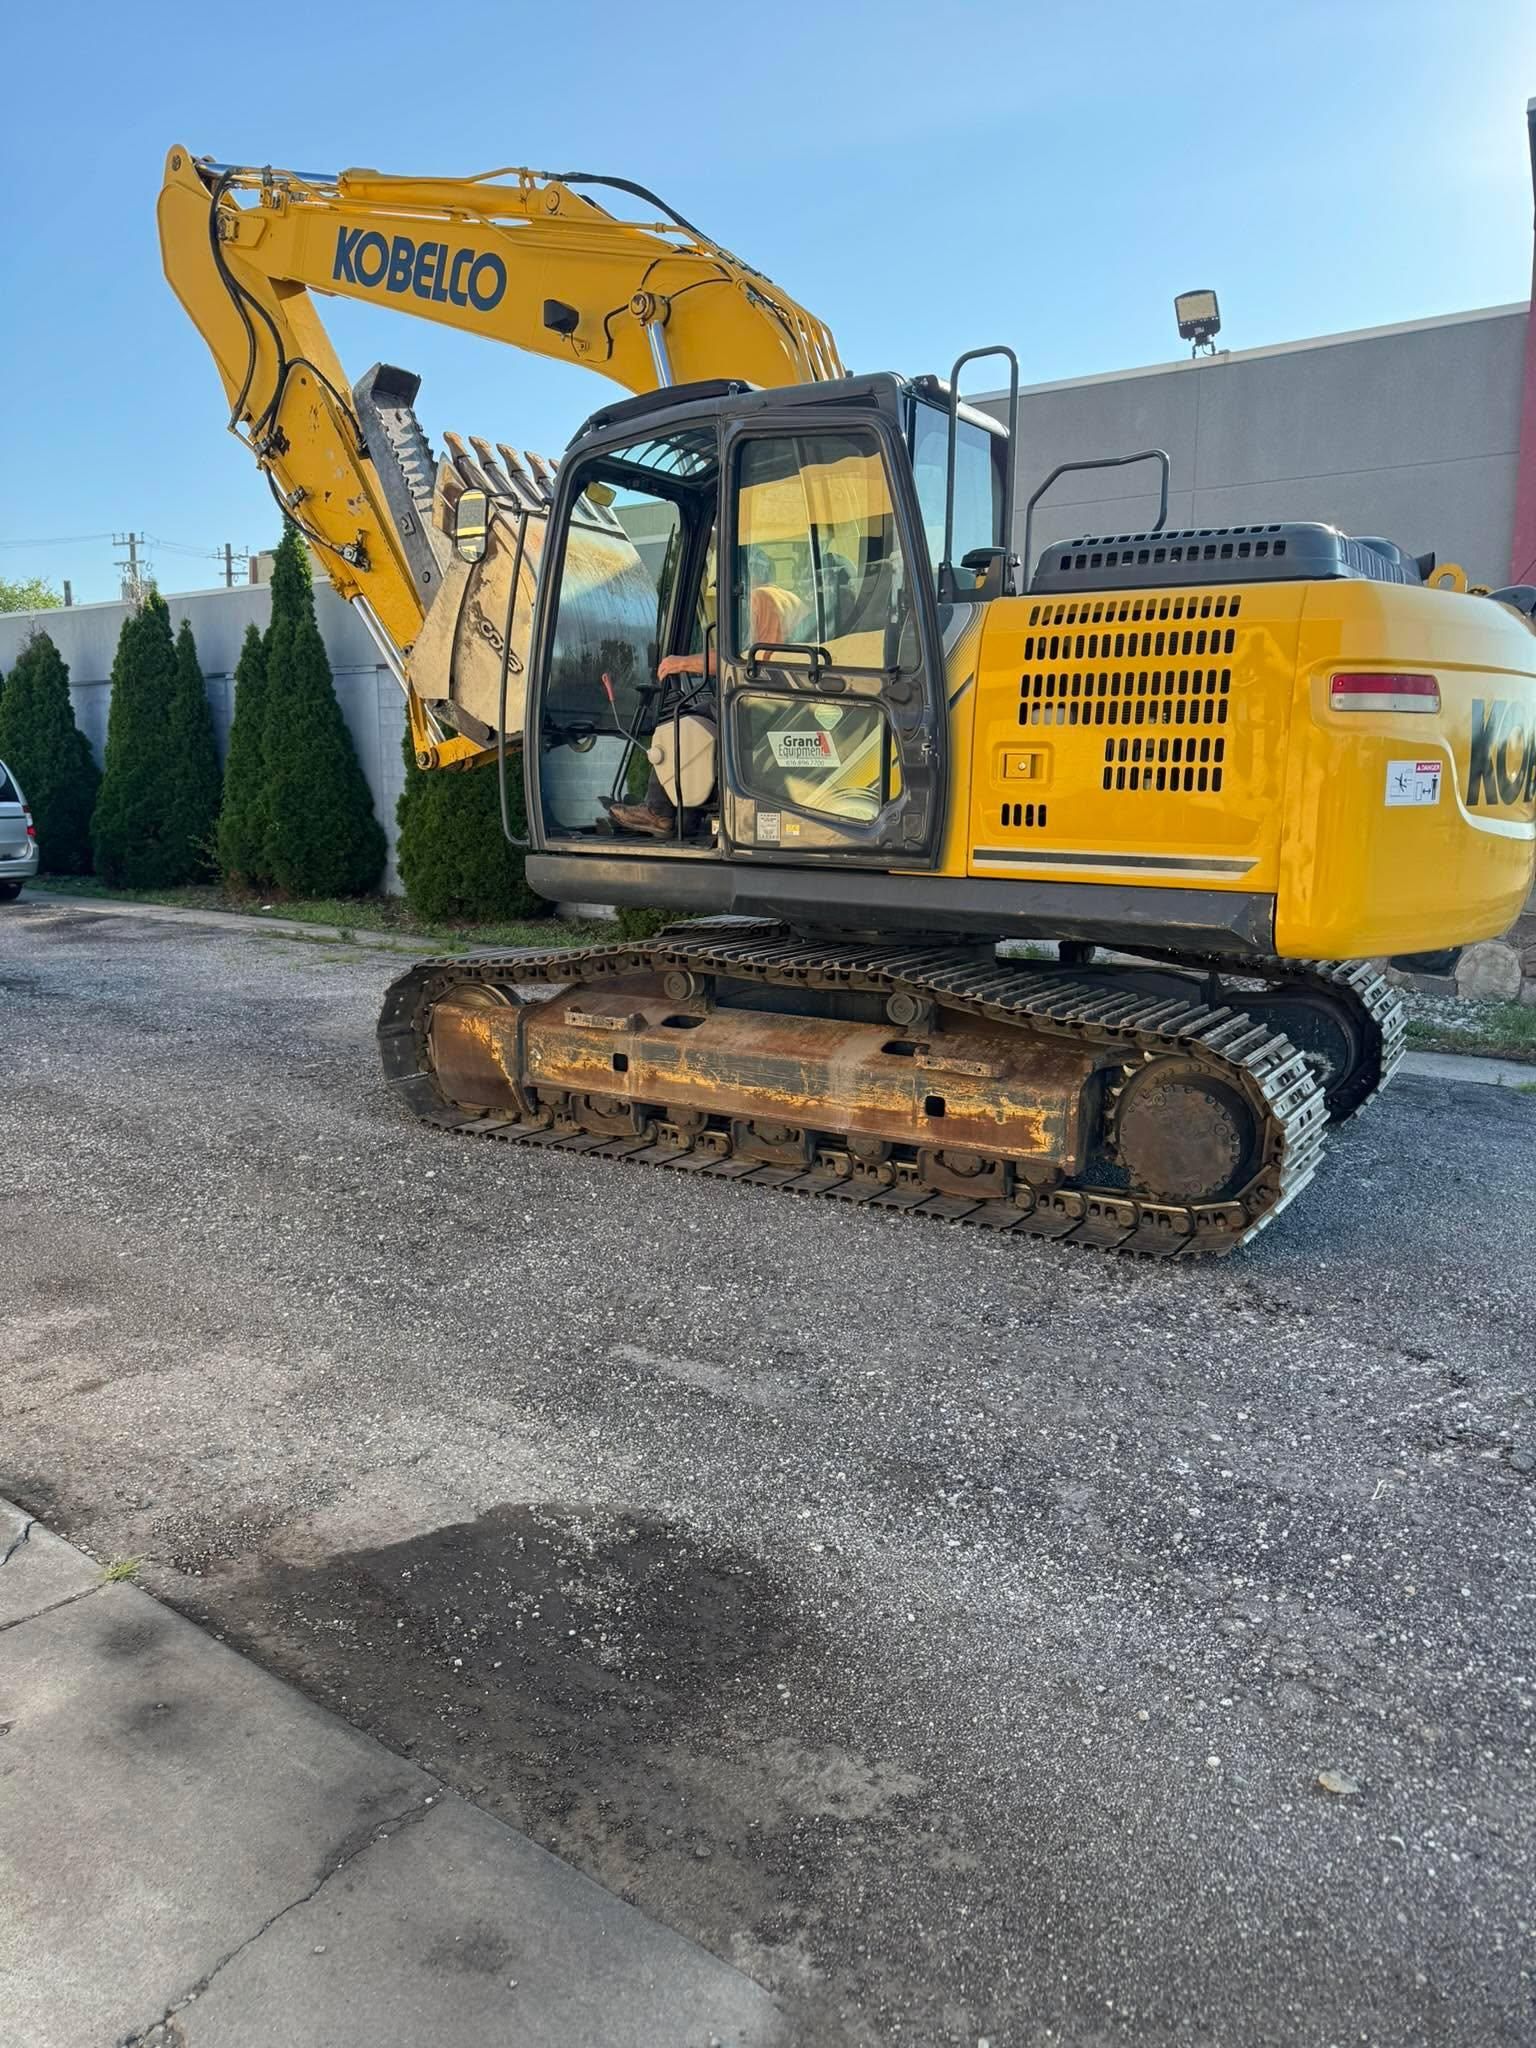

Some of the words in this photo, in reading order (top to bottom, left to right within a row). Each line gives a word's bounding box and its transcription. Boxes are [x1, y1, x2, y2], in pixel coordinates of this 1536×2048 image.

[333, 225, 507, 311] KOBELCO
[783, 735, 821, 747] Grand
[779, 743, 824, 758] Equipment
